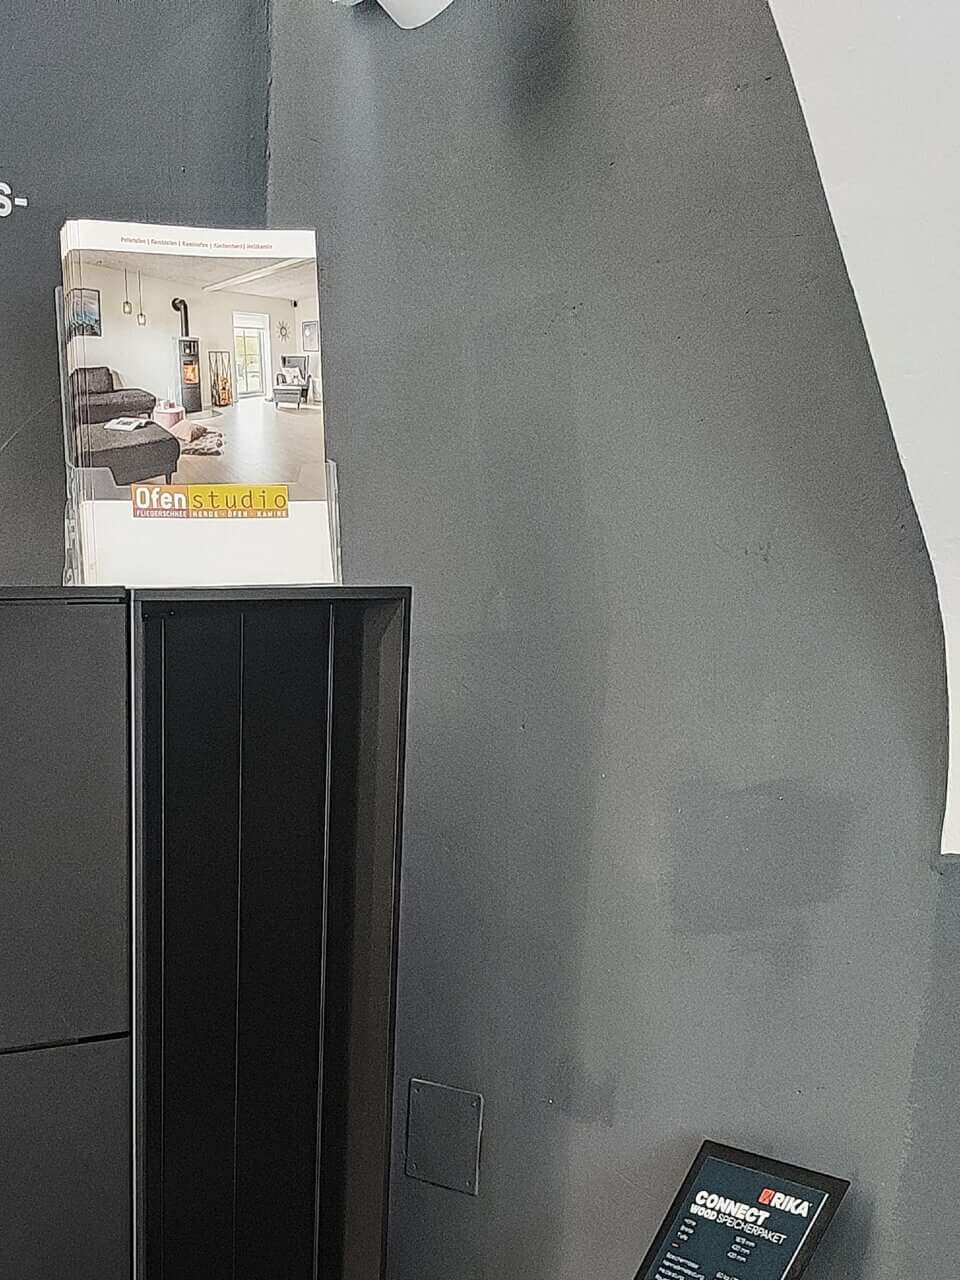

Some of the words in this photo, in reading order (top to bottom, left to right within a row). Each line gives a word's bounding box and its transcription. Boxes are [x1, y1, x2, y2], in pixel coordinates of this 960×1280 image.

[695, 1190, 770, 1226] CONNECT
[770, 1192, 810, 1218] RIKA
[689, 1203, 717, 1220] WOOD
[716, 1213, 788, 1245] SPEICHERPAKET
